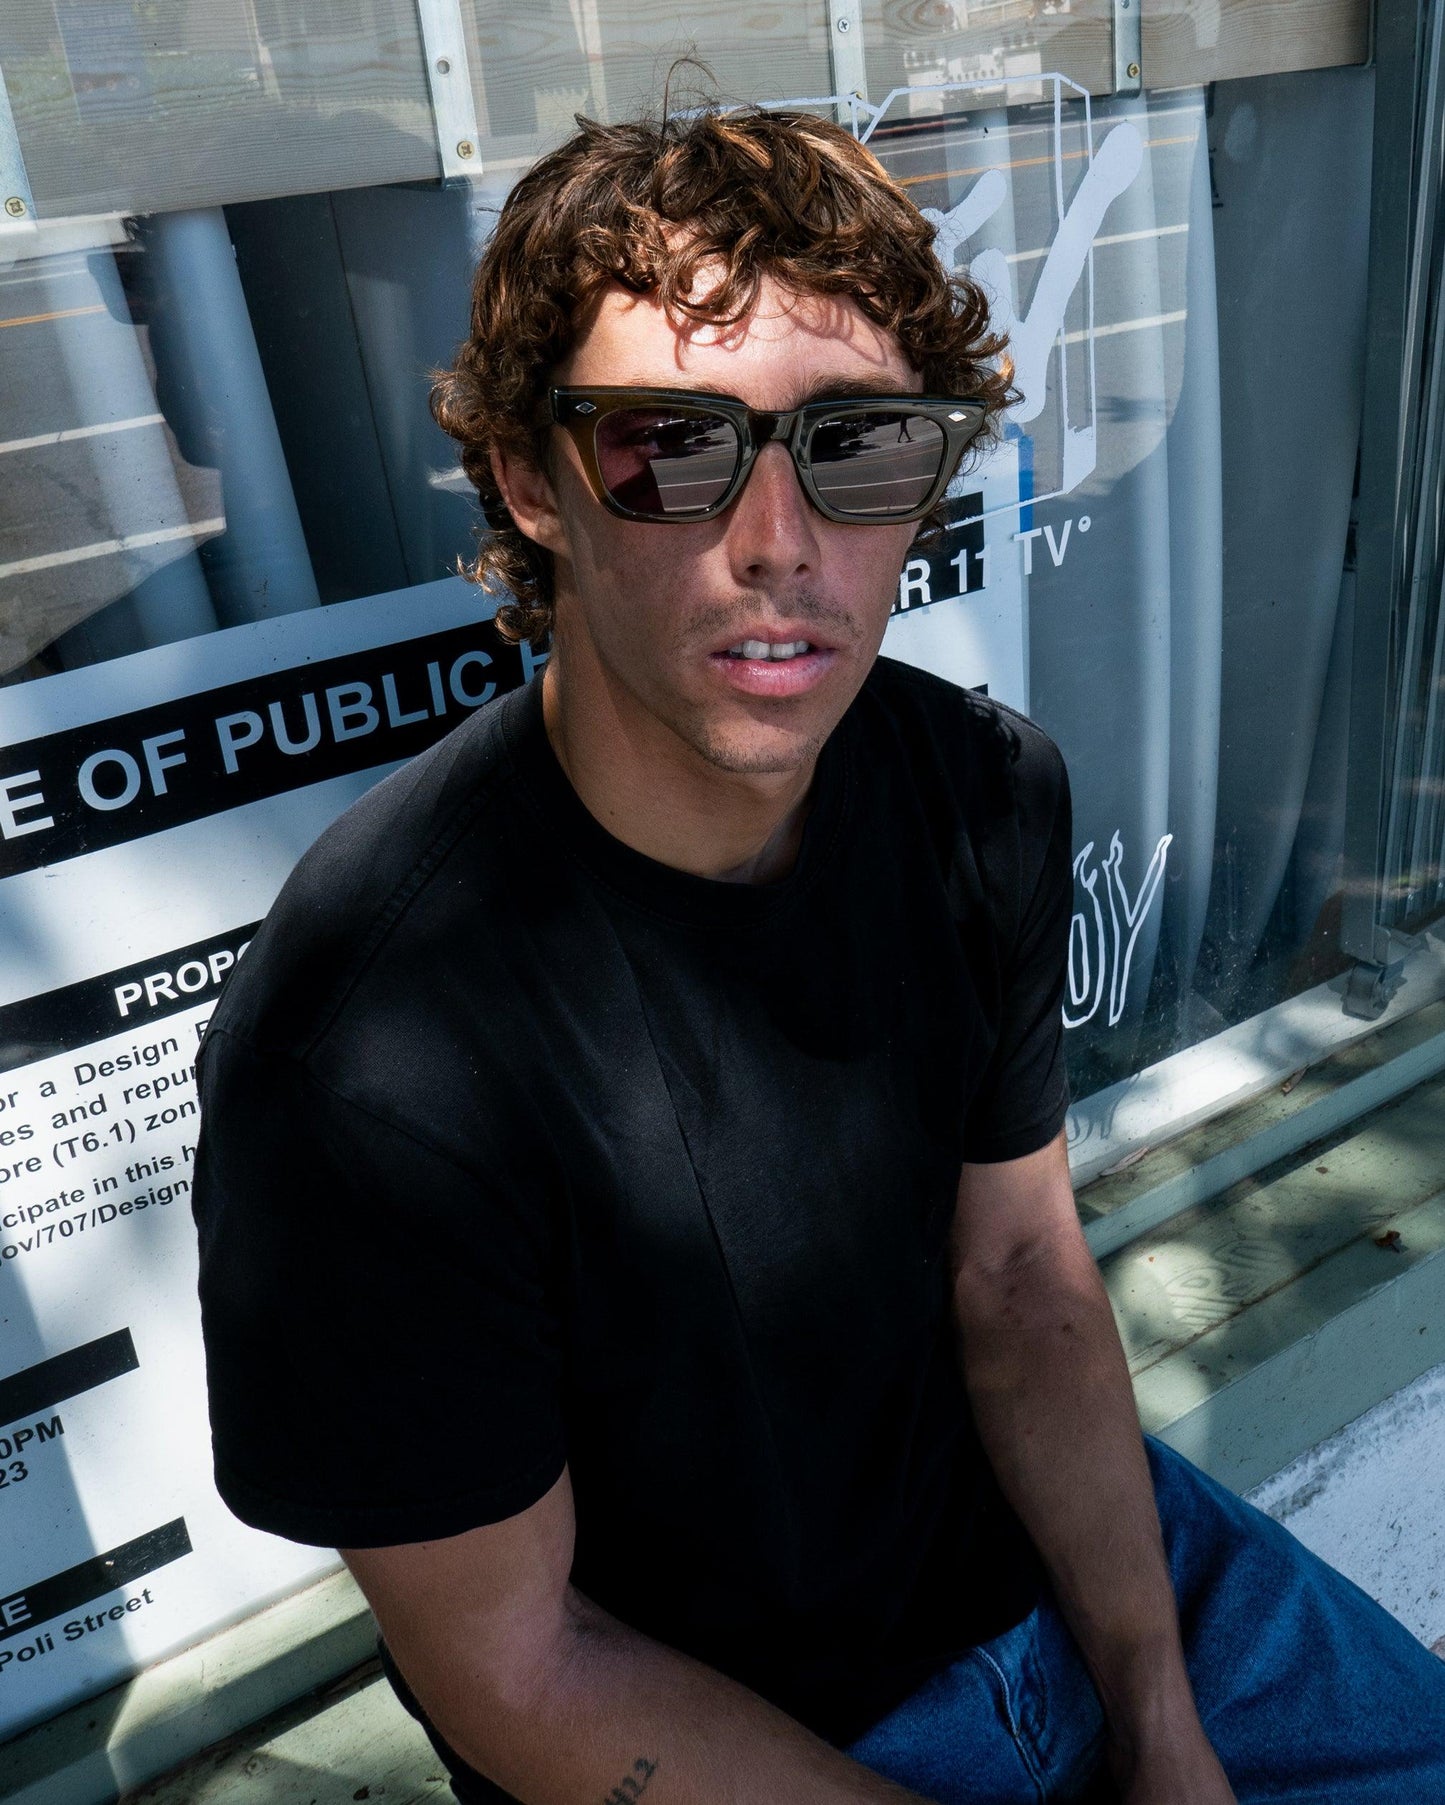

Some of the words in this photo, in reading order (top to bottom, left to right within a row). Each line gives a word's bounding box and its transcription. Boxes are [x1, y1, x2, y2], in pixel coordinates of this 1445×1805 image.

[895, 558, 932, 611] R
[951, 544, 992, 593] 11
[78, 728, 187, 811] OF
[214, 650, 497, 775] PUBLIC
[39, 1080, 57, 1098] a
[74, 1037, 179, 1087] Design
[51, 1093, 108, 1130] and
[52, 1118, 136, 1168] (T6.1)
[144, 1100, 198, 1132] zon
[0, 1188, 85, 1232] cipate
[93, 1176, 118, 1195] in
[125, 1154, 175, 1183] this
[0, 1178, 192, 1268] ov/707/Design
[0, 1596, 32, 1631] E
[0, 1632, 55, 1673] Poli
[63, 1588, 154, 1642] Street
